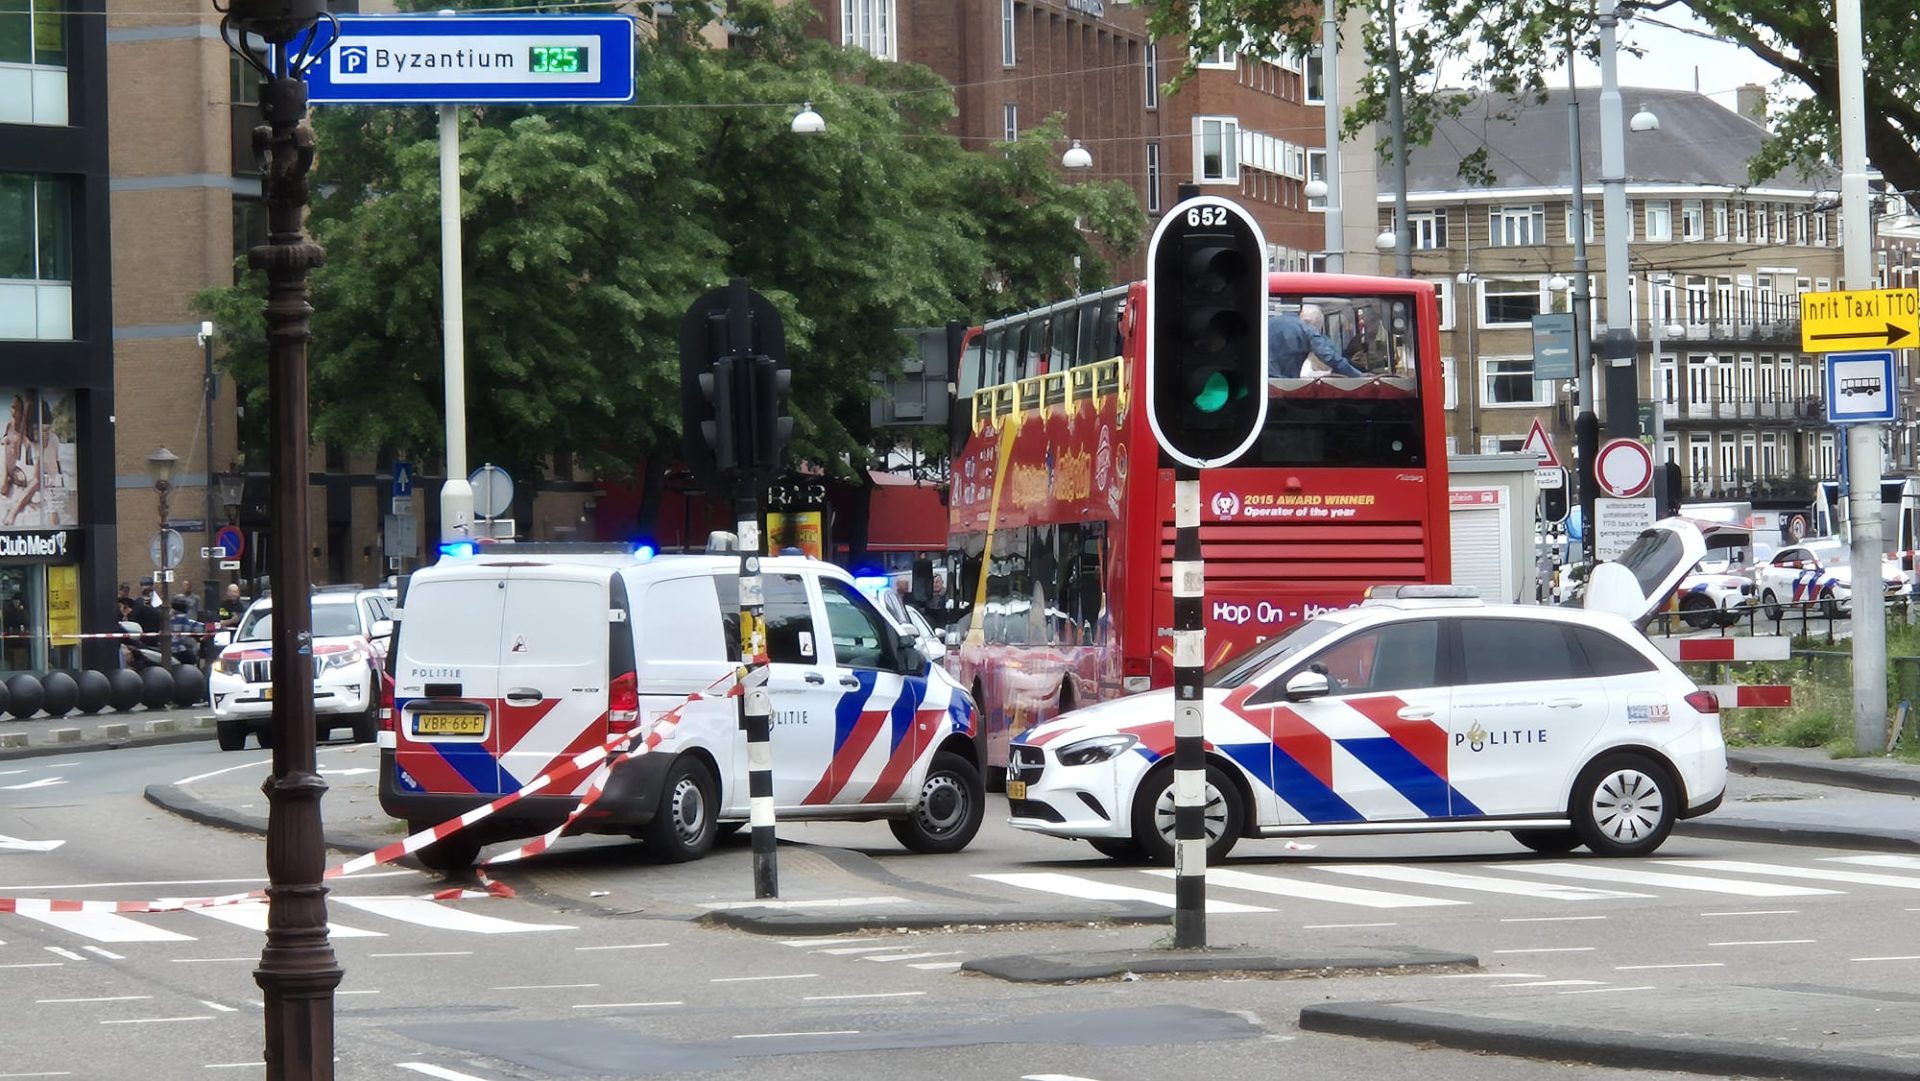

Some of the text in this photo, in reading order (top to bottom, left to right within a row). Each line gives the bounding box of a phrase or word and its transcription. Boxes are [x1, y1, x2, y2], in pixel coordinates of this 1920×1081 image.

[376, 49, 514, 72] Byzantium
[1187, 207, 1227, 227] 652
[1803, 293, 1915, 320] Inrit Taxi TTO
[1244, 495, 1375, 505] 2015 AWARD WINNER
[1244, 507, 1356, 518] Operator of the year
[1213, 602, 1251, 624] Hop
[1257, 602, 1283, 623] On
[411, 669, 461, 678] POLITIE
[1455, 729, 1547, 752] POLITIE
